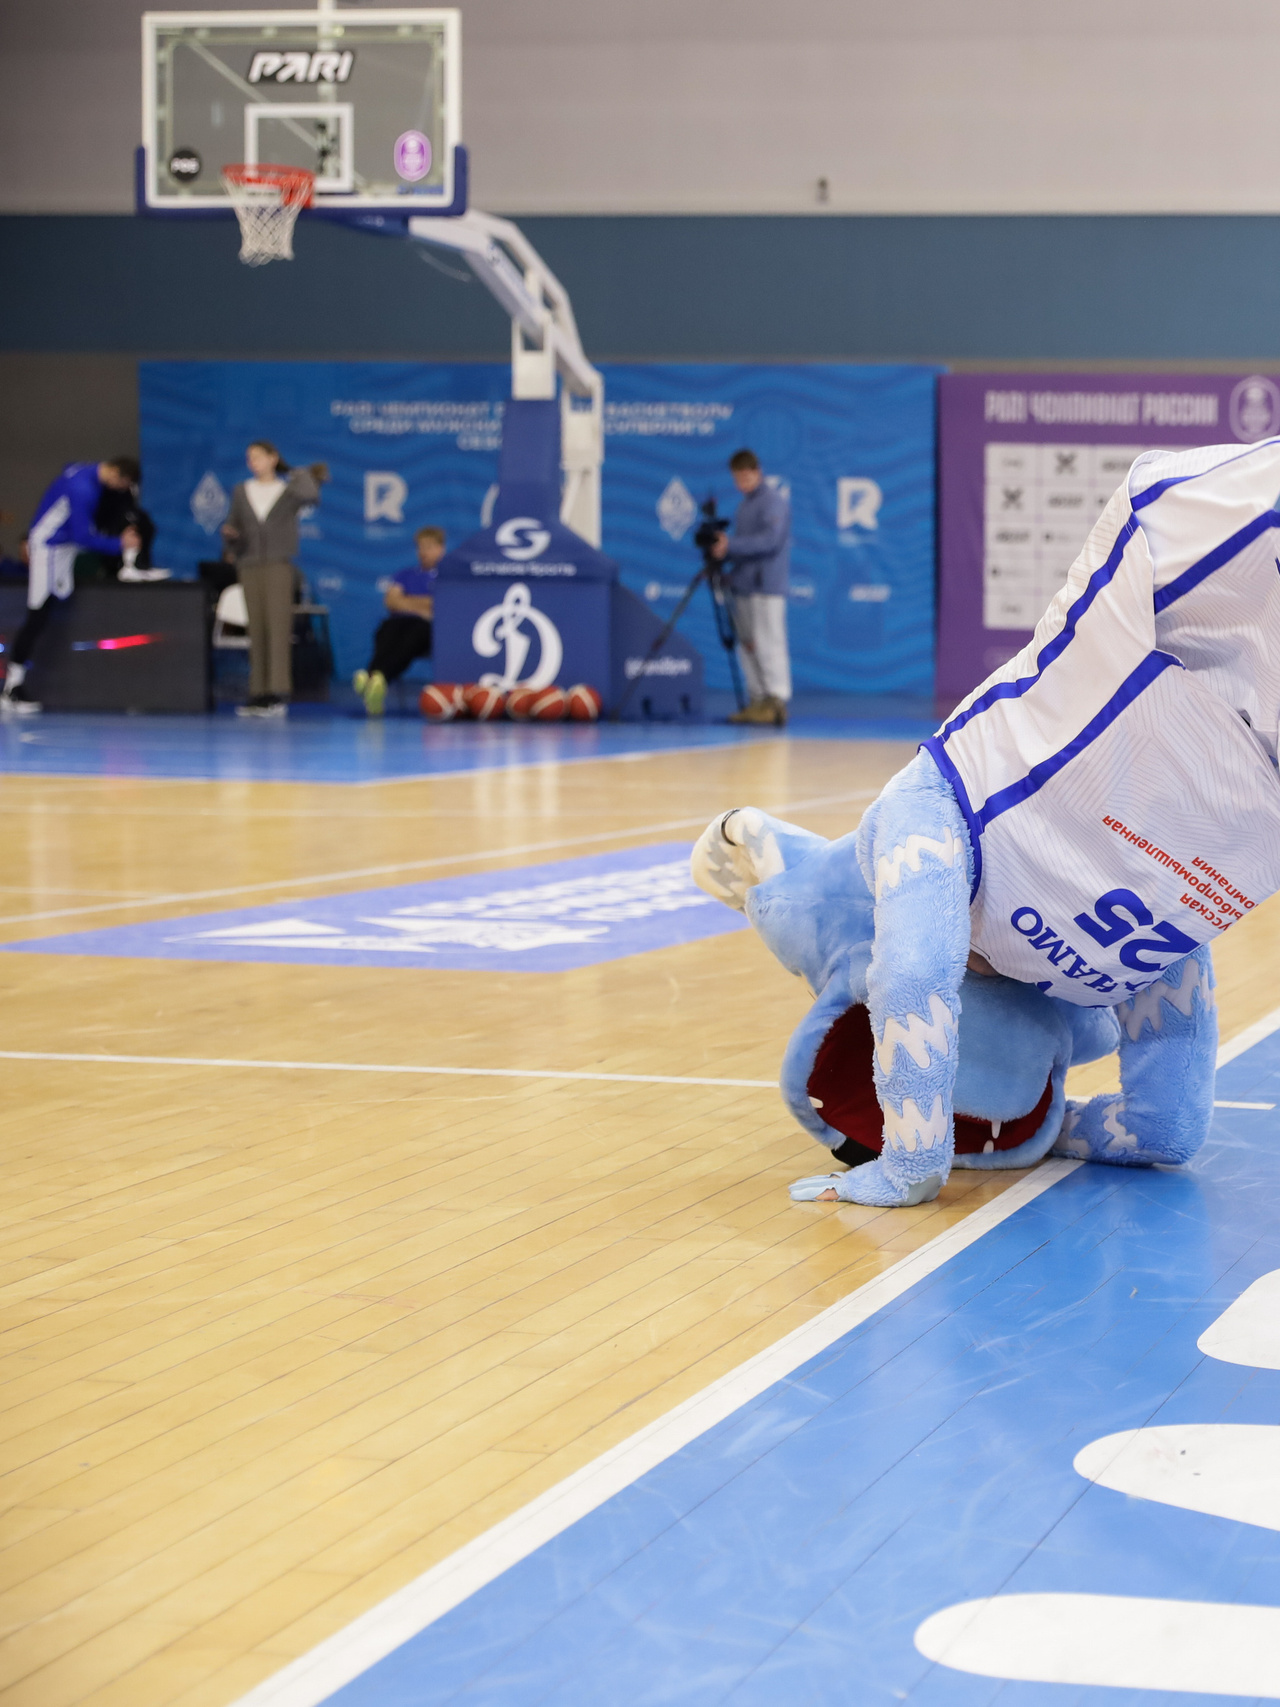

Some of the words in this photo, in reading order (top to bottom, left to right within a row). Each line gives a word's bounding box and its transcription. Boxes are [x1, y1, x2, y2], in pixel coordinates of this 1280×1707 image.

[248, 51, 355, 83] PARI
[1102, 815, 1245, 921] ыбопромышленная
[1191, 857, 1259, 910] омпания
[1073, 888, 1201, 973] 25
[1179, 893, 1233, 932] усская
